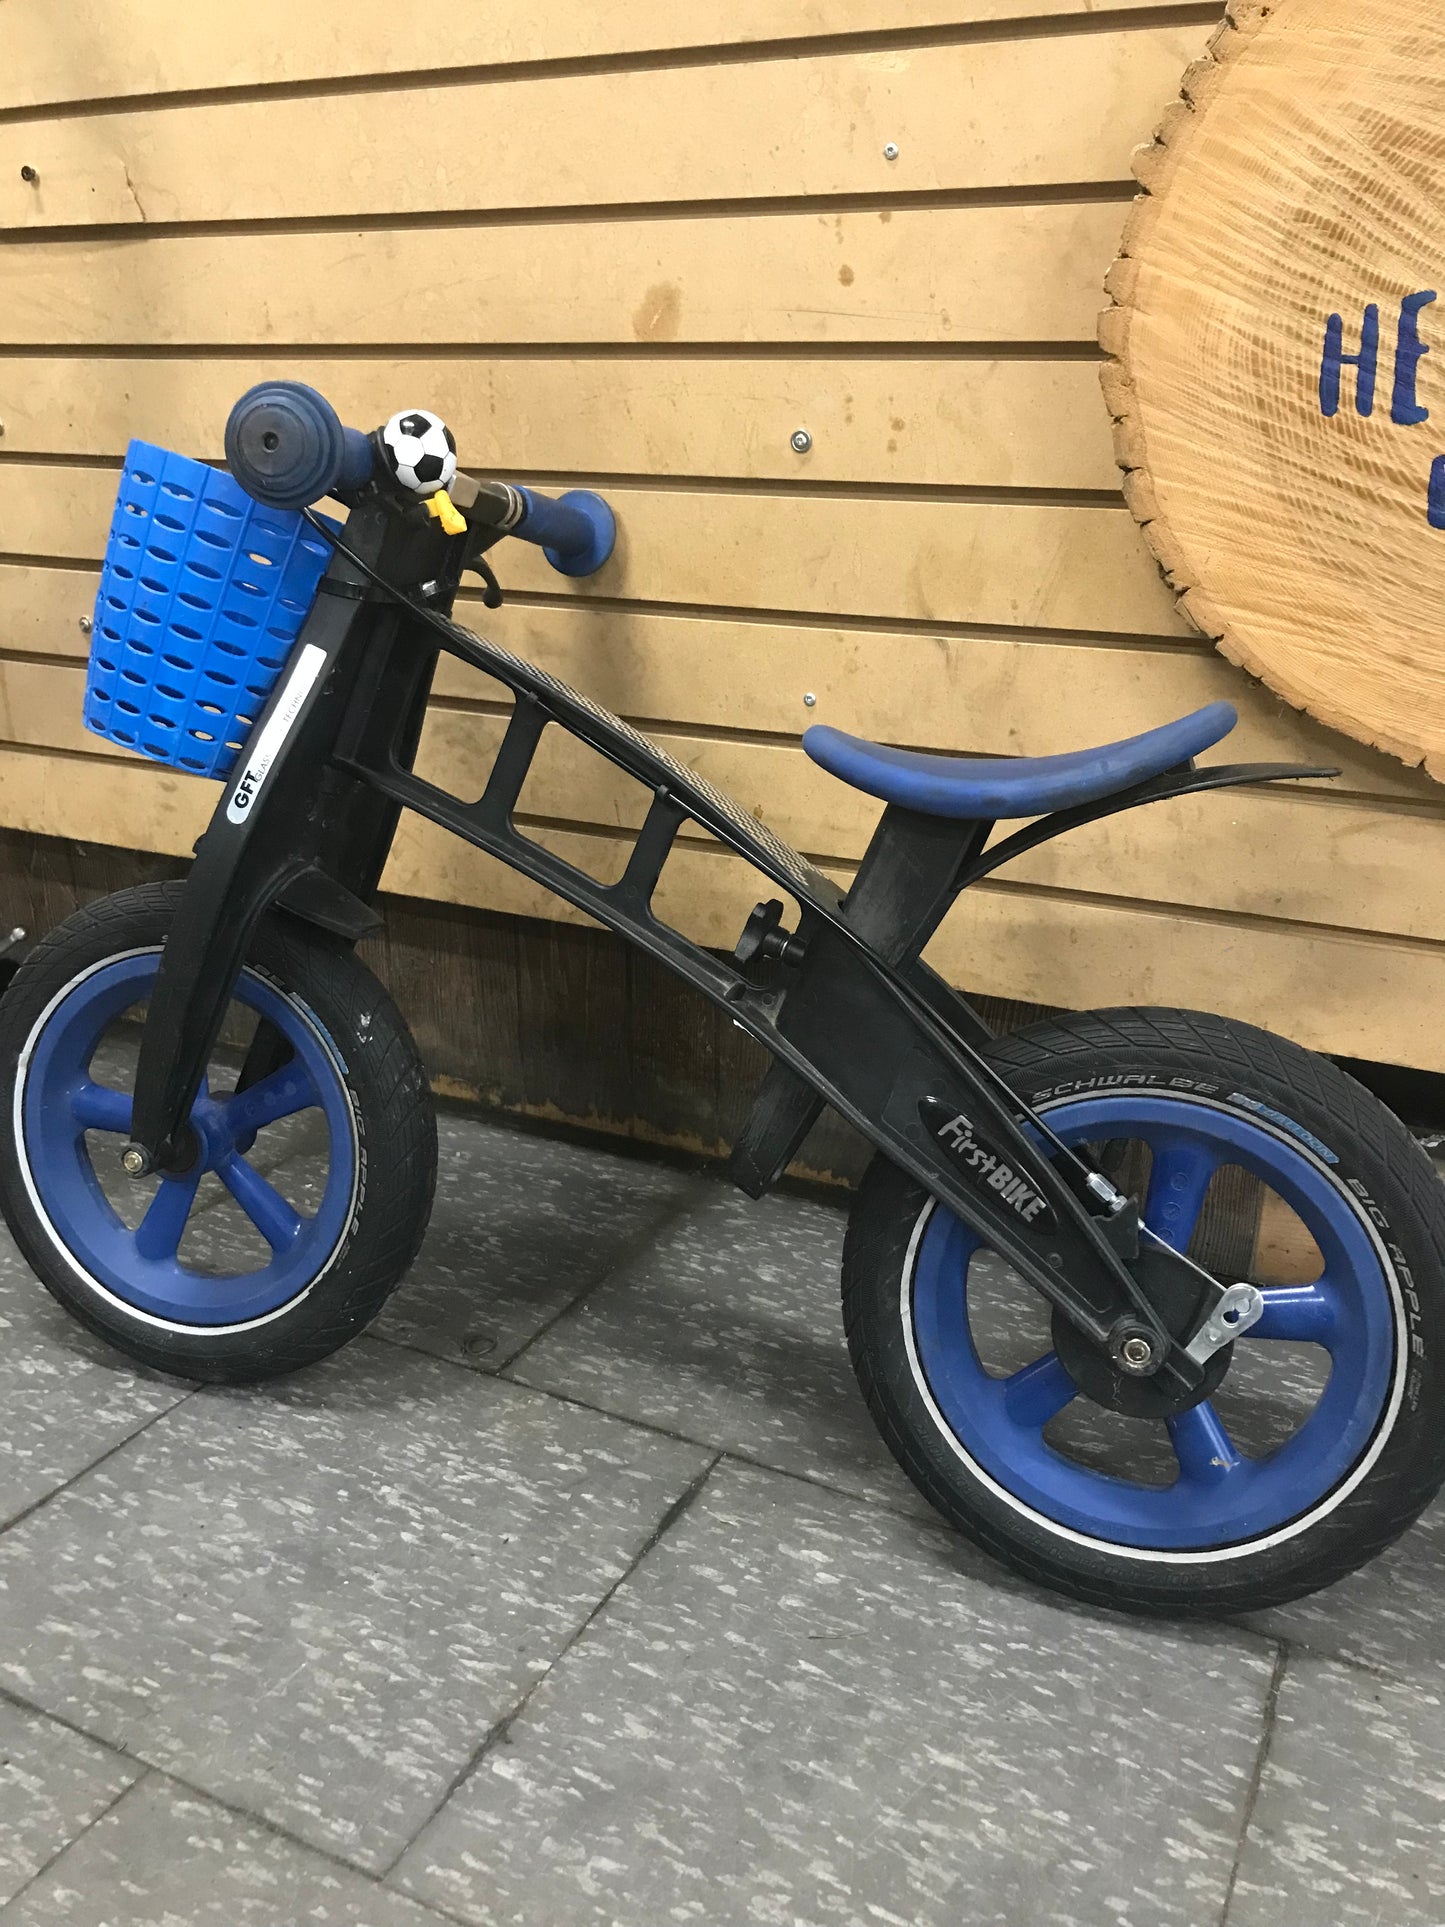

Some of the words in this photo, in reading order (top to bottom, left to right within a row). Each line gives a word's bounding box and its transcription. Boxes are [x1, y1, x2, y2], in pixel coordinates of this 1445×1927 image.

[1319, 289, 1437, 426] HE
[234, 770, 259, 809] GFT
[350, 1089, 367, 1137] BIG
[1031, 1073, 1220, 1104] SCHWALBE
[350, 1145, 369, 1236] APPLE
[937, 1114, 1047, 1223] FirstBIKE
[1347, 1178, 1390, 1229] BIG
[1388, 1242, 1425, 1358] APPLE
